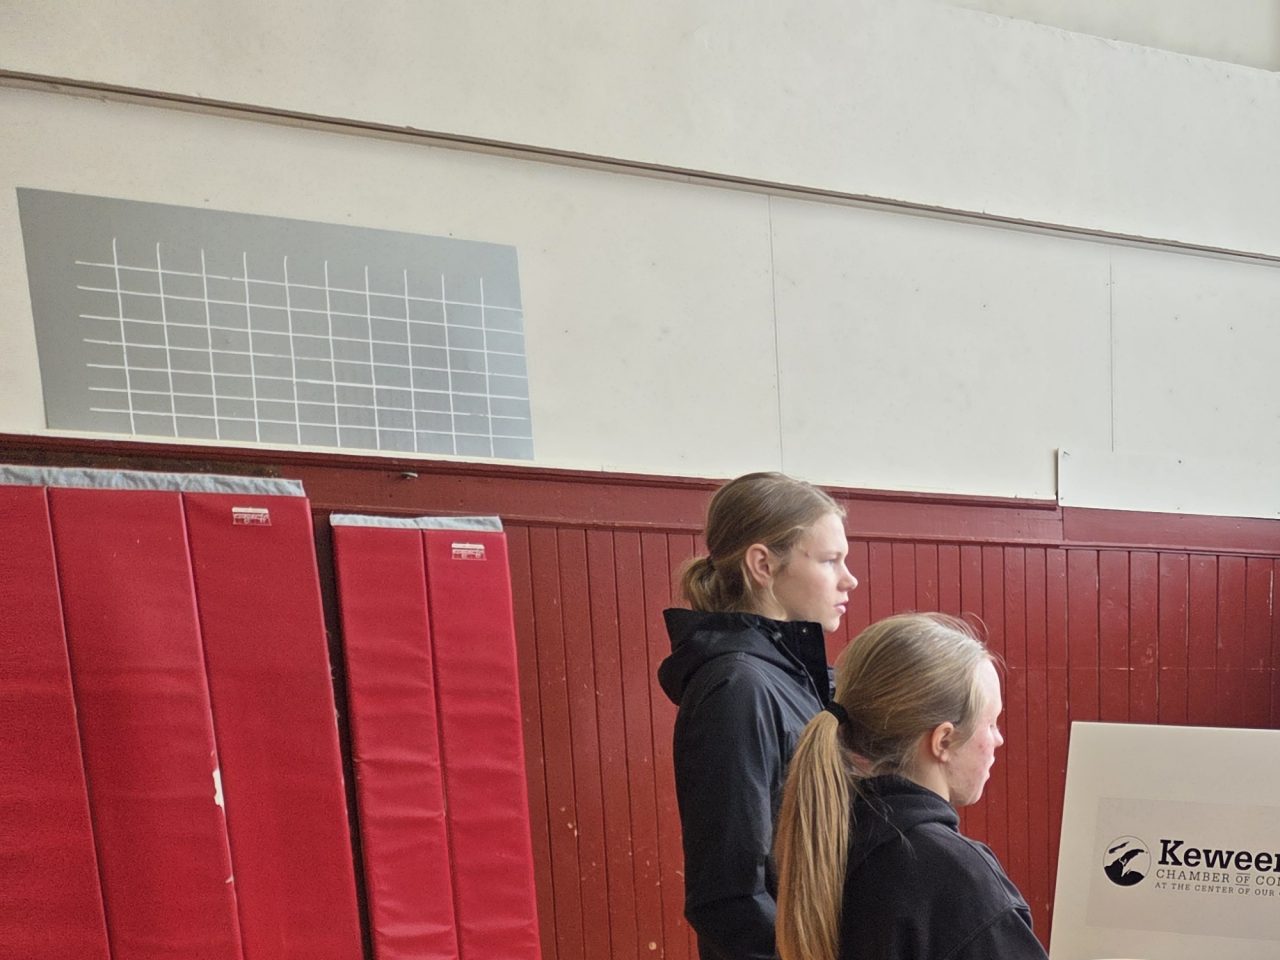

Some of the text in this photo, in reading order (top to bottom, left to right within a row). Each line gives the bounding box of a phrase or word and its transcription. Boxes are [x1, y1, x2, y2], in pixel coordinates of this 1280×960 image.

[1156, 869, 1230, 884] CHAMBER
[1235, 873, 1251, 886] OF
[1155, 882, 1168, 890] AT
[1171, 883, 1191, 892] THE
[1194, 884, 1235, 895] CENTER
[1237, 887, 1251, 895] OF
[1255, 888, 1275, 898] OUR
